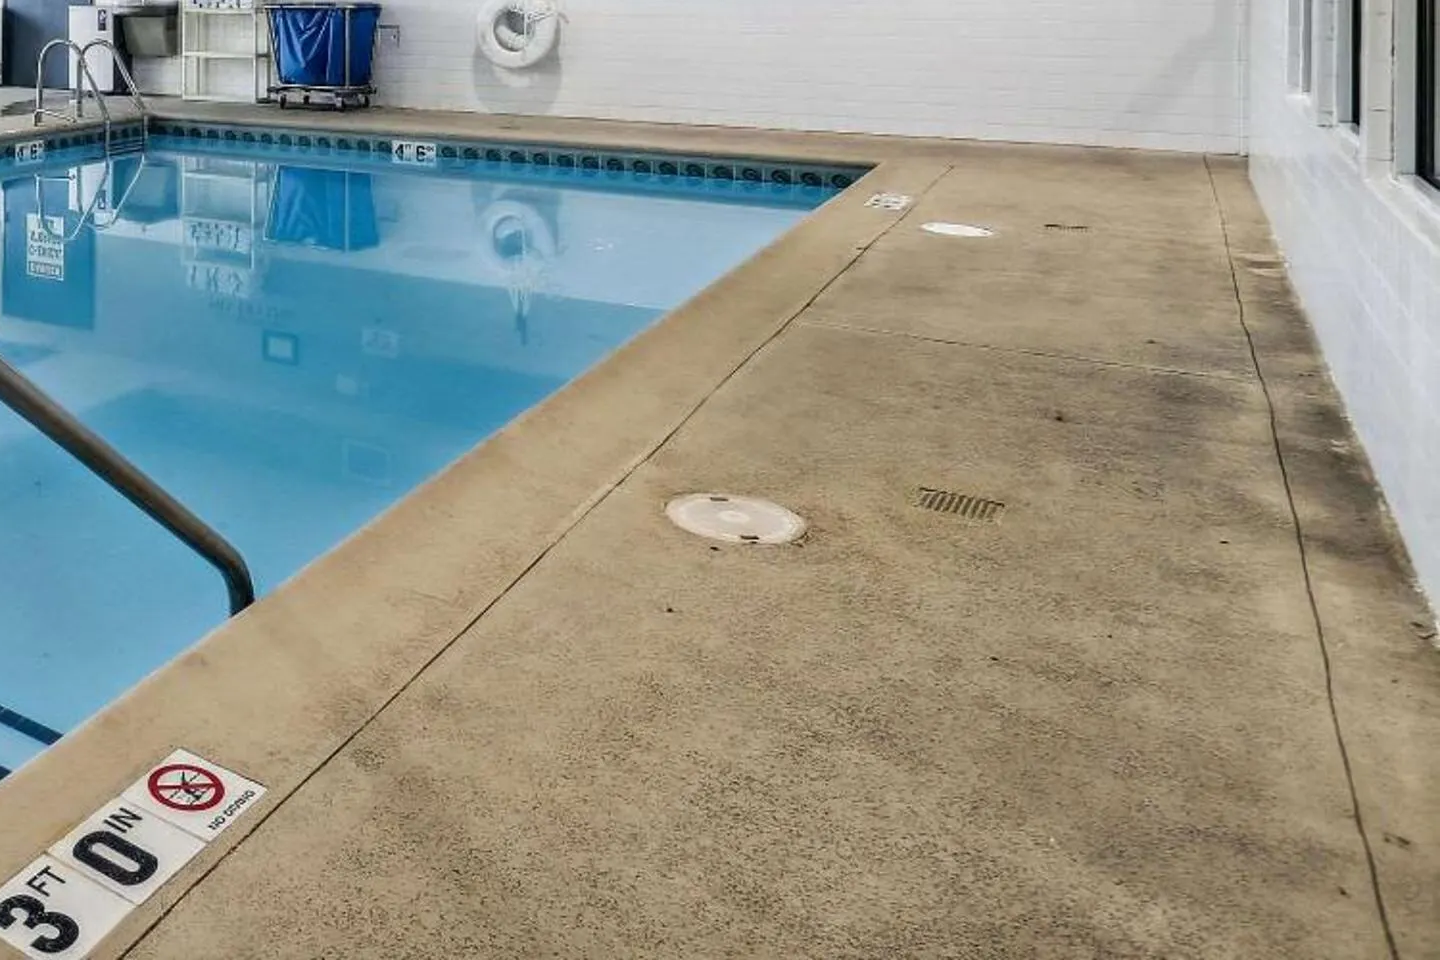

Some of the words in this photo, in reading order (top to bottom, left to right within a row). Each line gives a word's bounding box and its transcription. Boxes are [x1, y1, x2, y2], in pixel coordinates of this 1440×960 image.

[103, 807, 143, 834] IN
[72, 829, 159, 887] 0
[26, 865, 67, 898] FT
